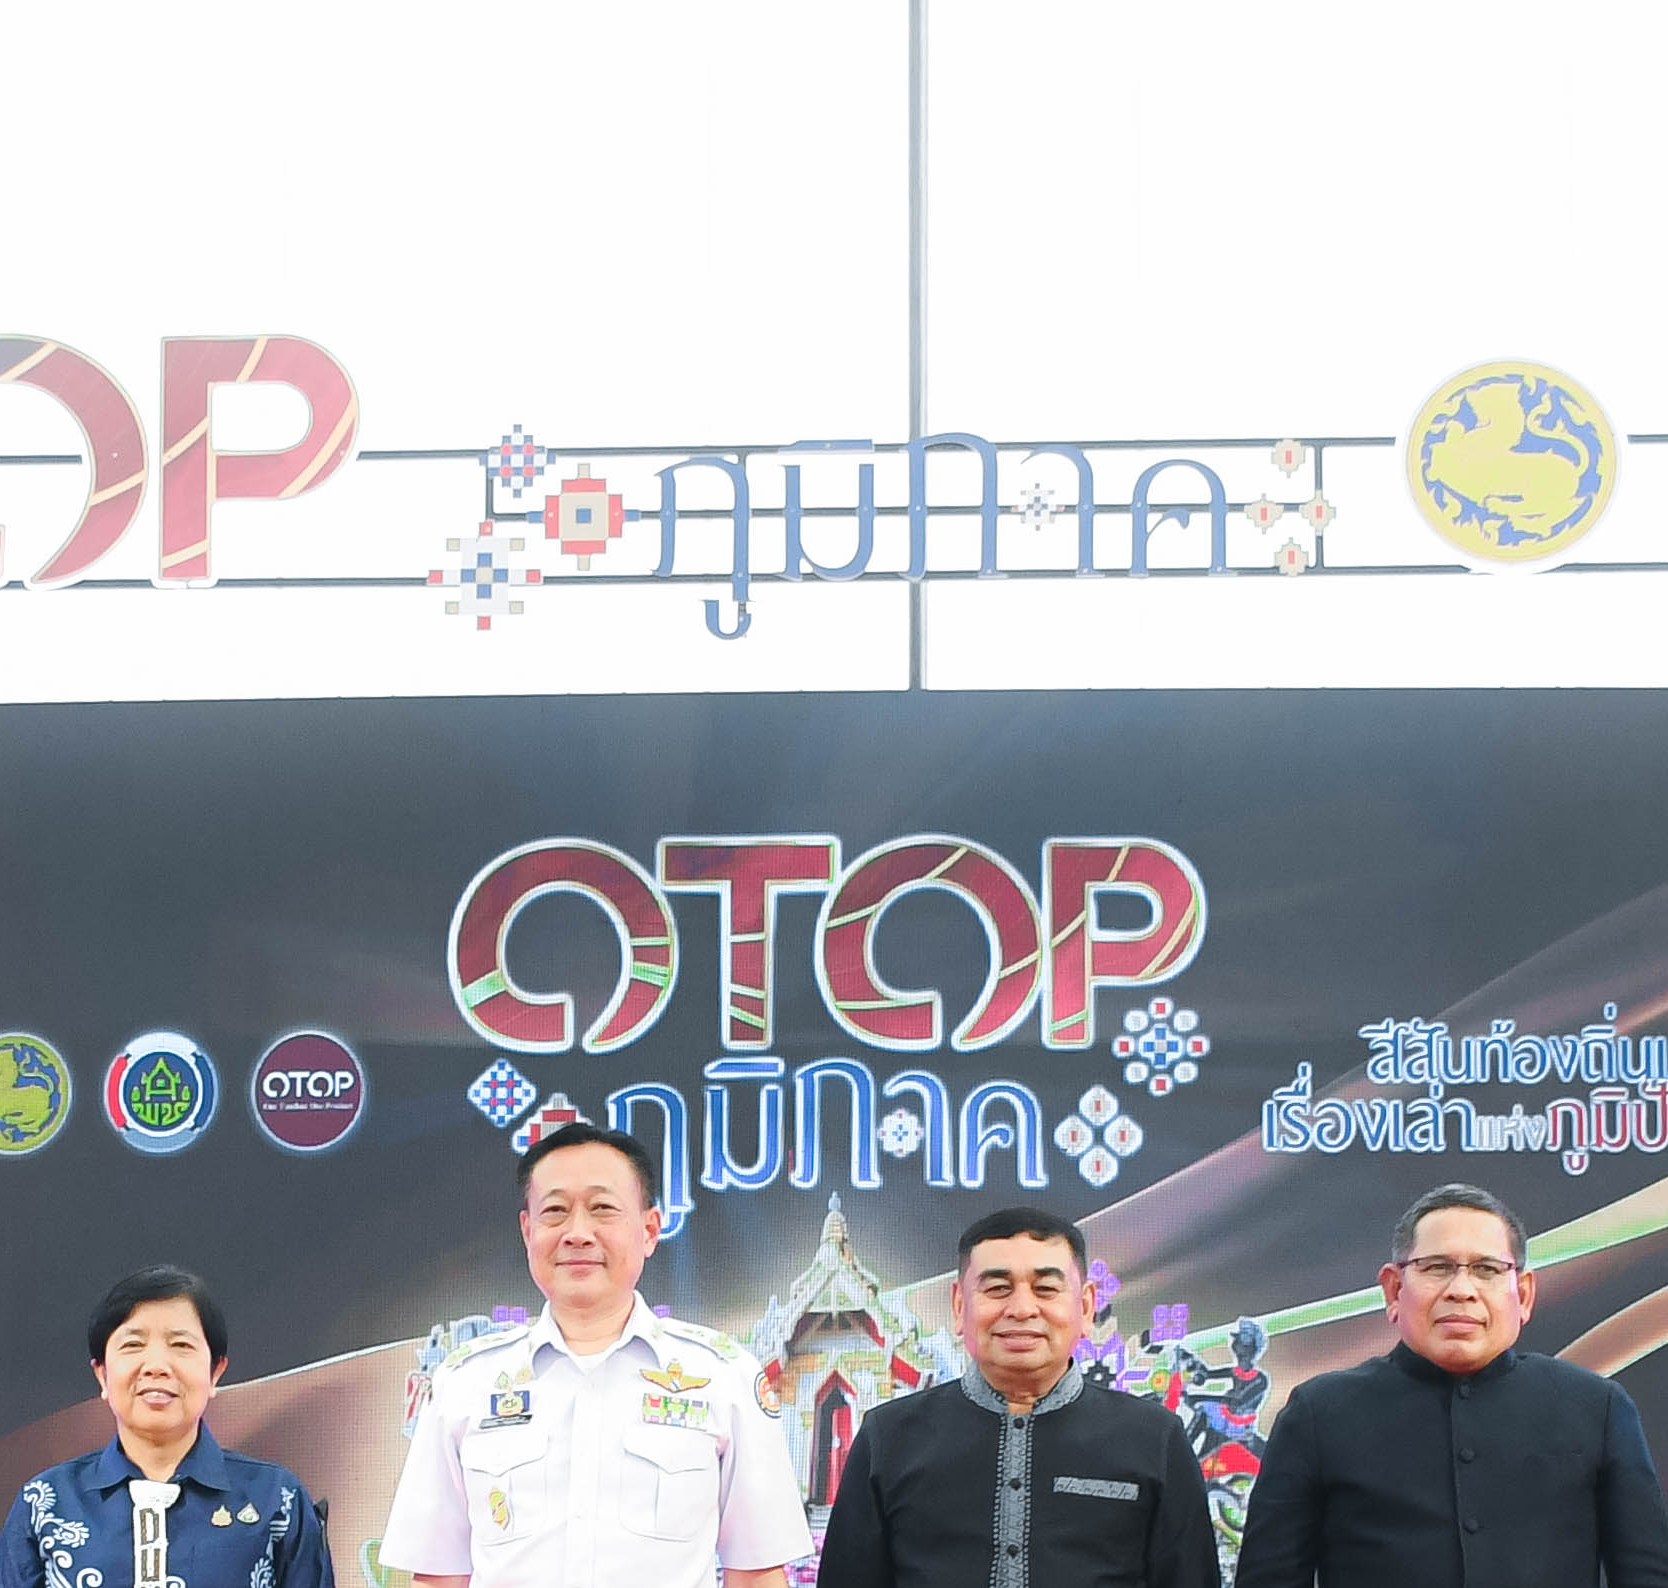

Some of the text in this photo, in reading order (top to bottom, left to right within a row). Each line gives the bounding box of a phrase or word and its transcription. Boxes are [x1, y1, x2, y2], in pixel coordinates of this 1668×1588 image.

[650, 432, 1237, 639] ภูมิภาค
[447, 834, 1206, 1052] OTOP
[262, 1071, 355, 1098] OTOP
